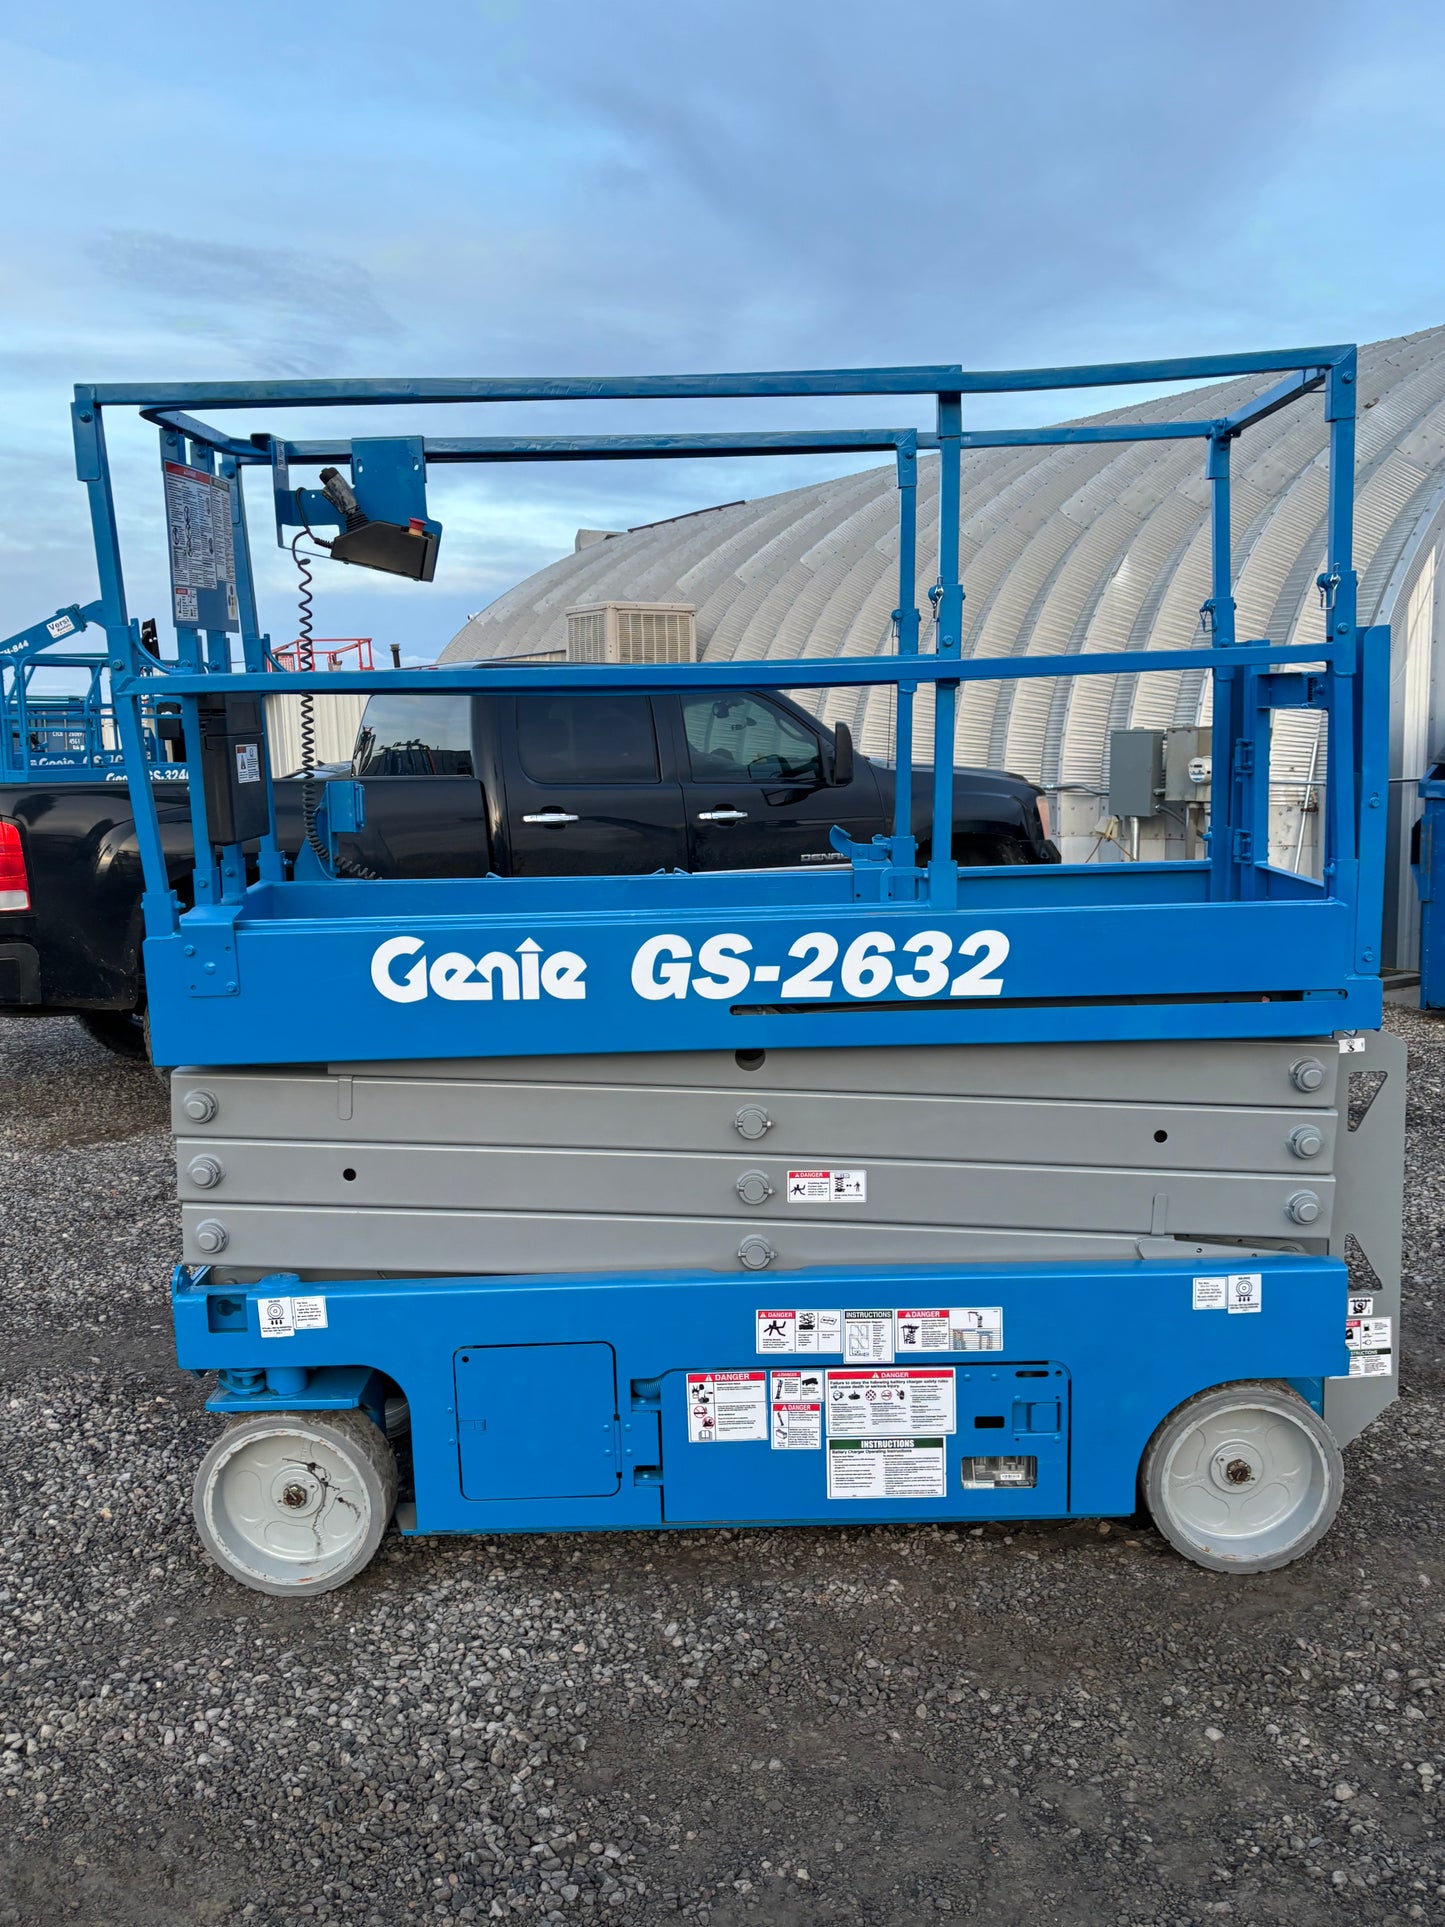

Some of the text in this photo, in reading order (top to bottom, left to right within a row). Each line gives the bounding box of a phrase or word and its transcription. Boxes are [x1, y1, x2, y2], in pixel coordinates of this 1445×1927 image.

[370, 930, 1010, 1003] Genie GS-2632
[715, 1373, 750, 1381] DANGER
[861, 1440, 914, 1448] INSTRUCTIONS
